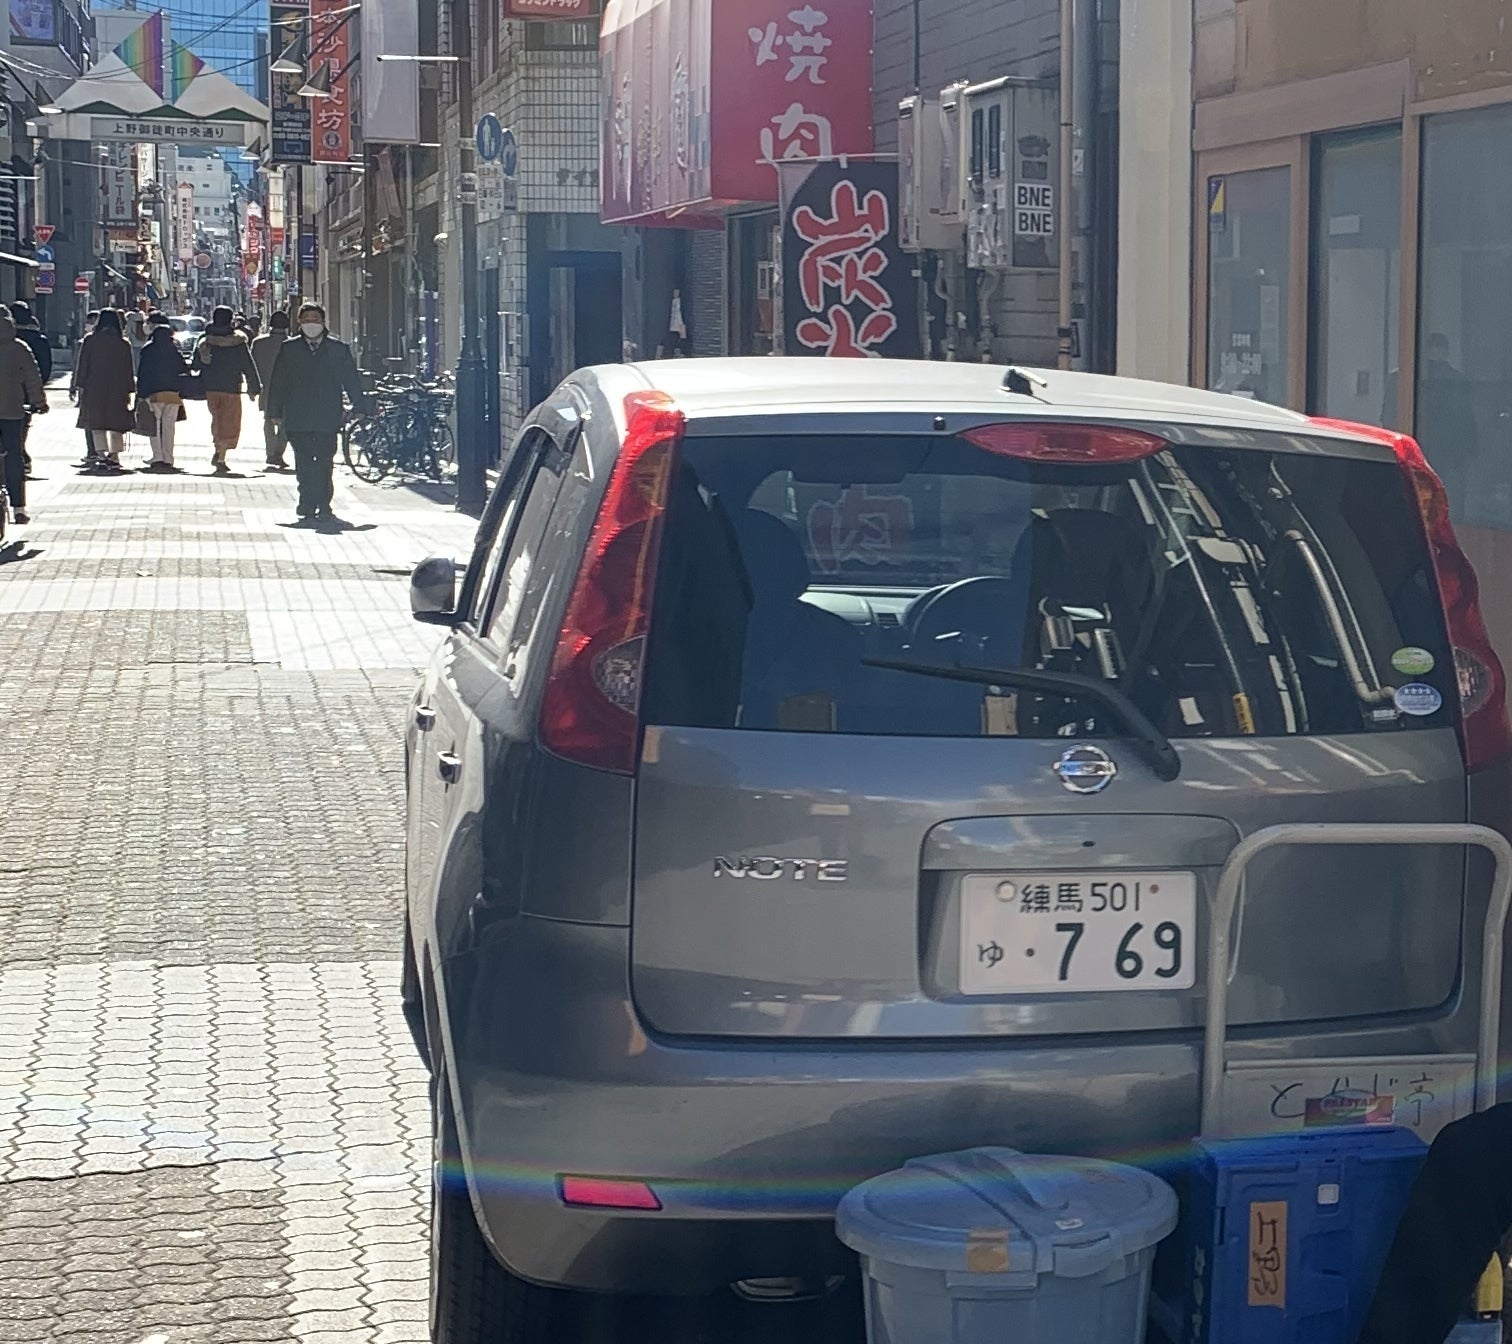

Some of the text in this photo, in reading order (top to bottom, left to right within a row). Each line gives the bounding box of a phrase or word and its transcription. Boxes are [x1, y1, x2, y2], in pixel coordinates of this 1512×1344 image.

[747, 5, 833, 162] 焼肉
[112, 121, 225, 139] 上野御徒町中央通り
[1017, 185, 1051, 208] BNE
[1018, 211, 1052, 233] BNE
[713, 855, 849, 882] NOTE
